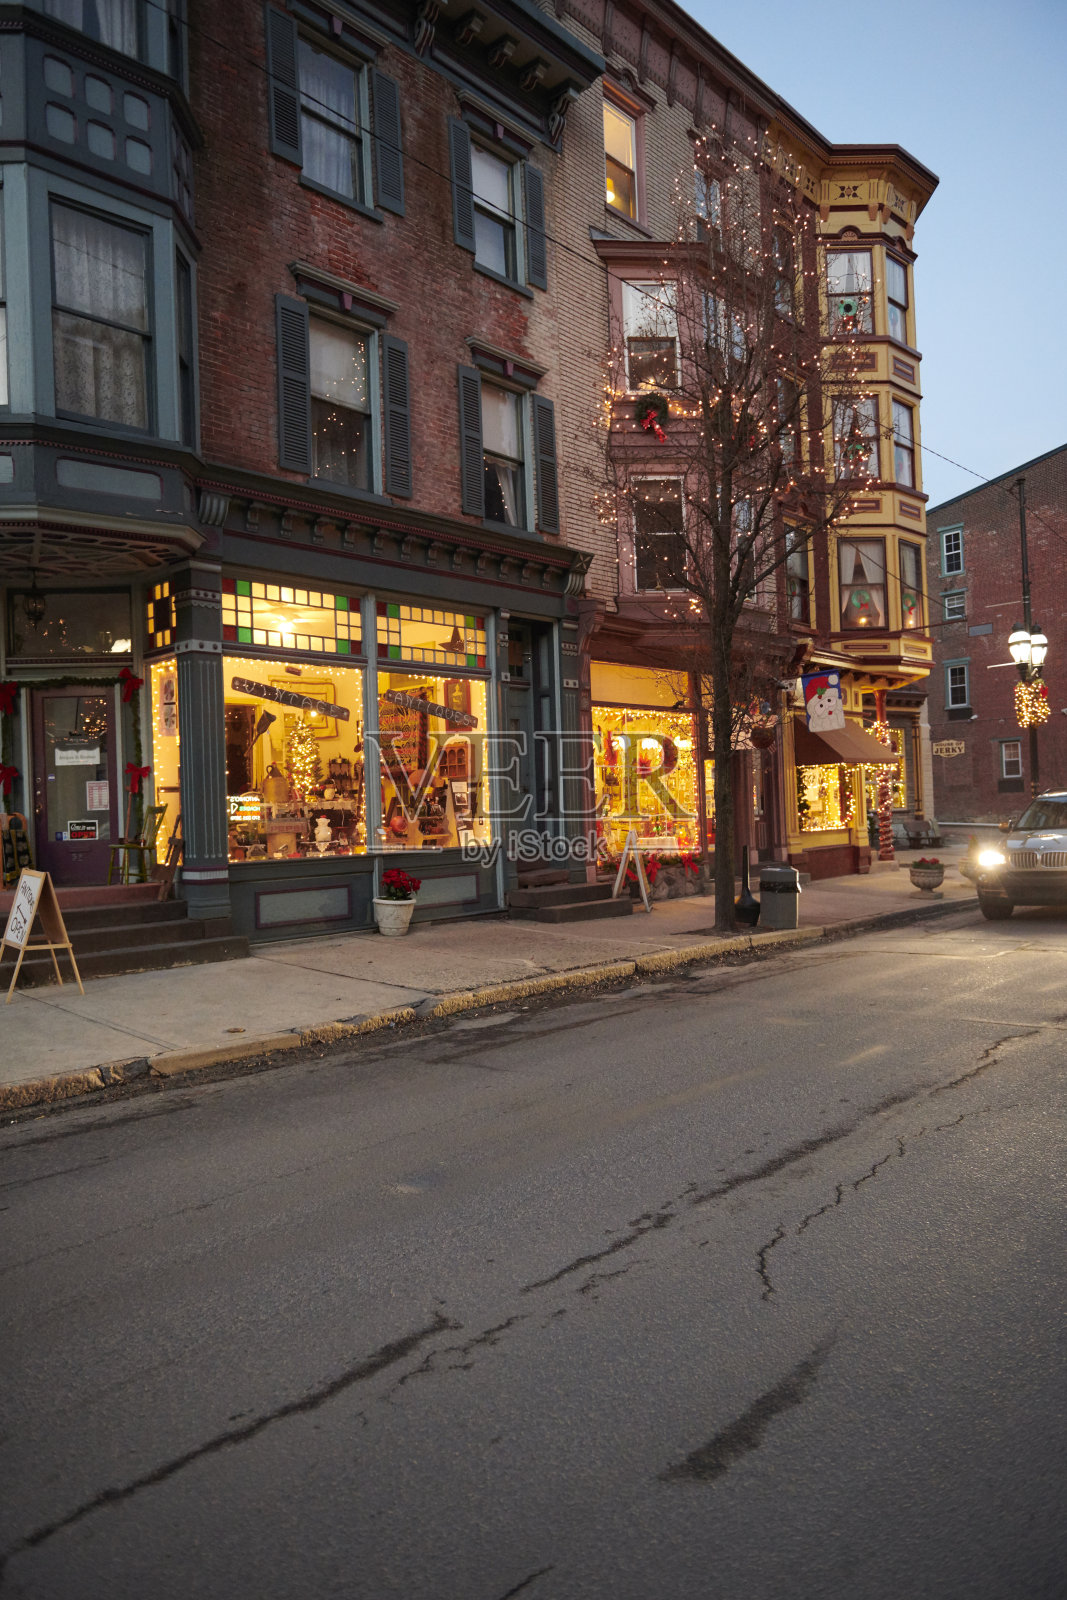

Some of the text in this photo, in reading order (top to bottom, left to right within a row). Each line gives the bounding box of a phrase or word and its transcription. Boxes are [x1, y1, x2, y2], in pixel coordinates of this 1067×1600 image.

[244, 679, 341, 717] VINTAGE
[394, 692, 469, 726] ANTIQUES
[10, 917, 26, 942] OPEN
